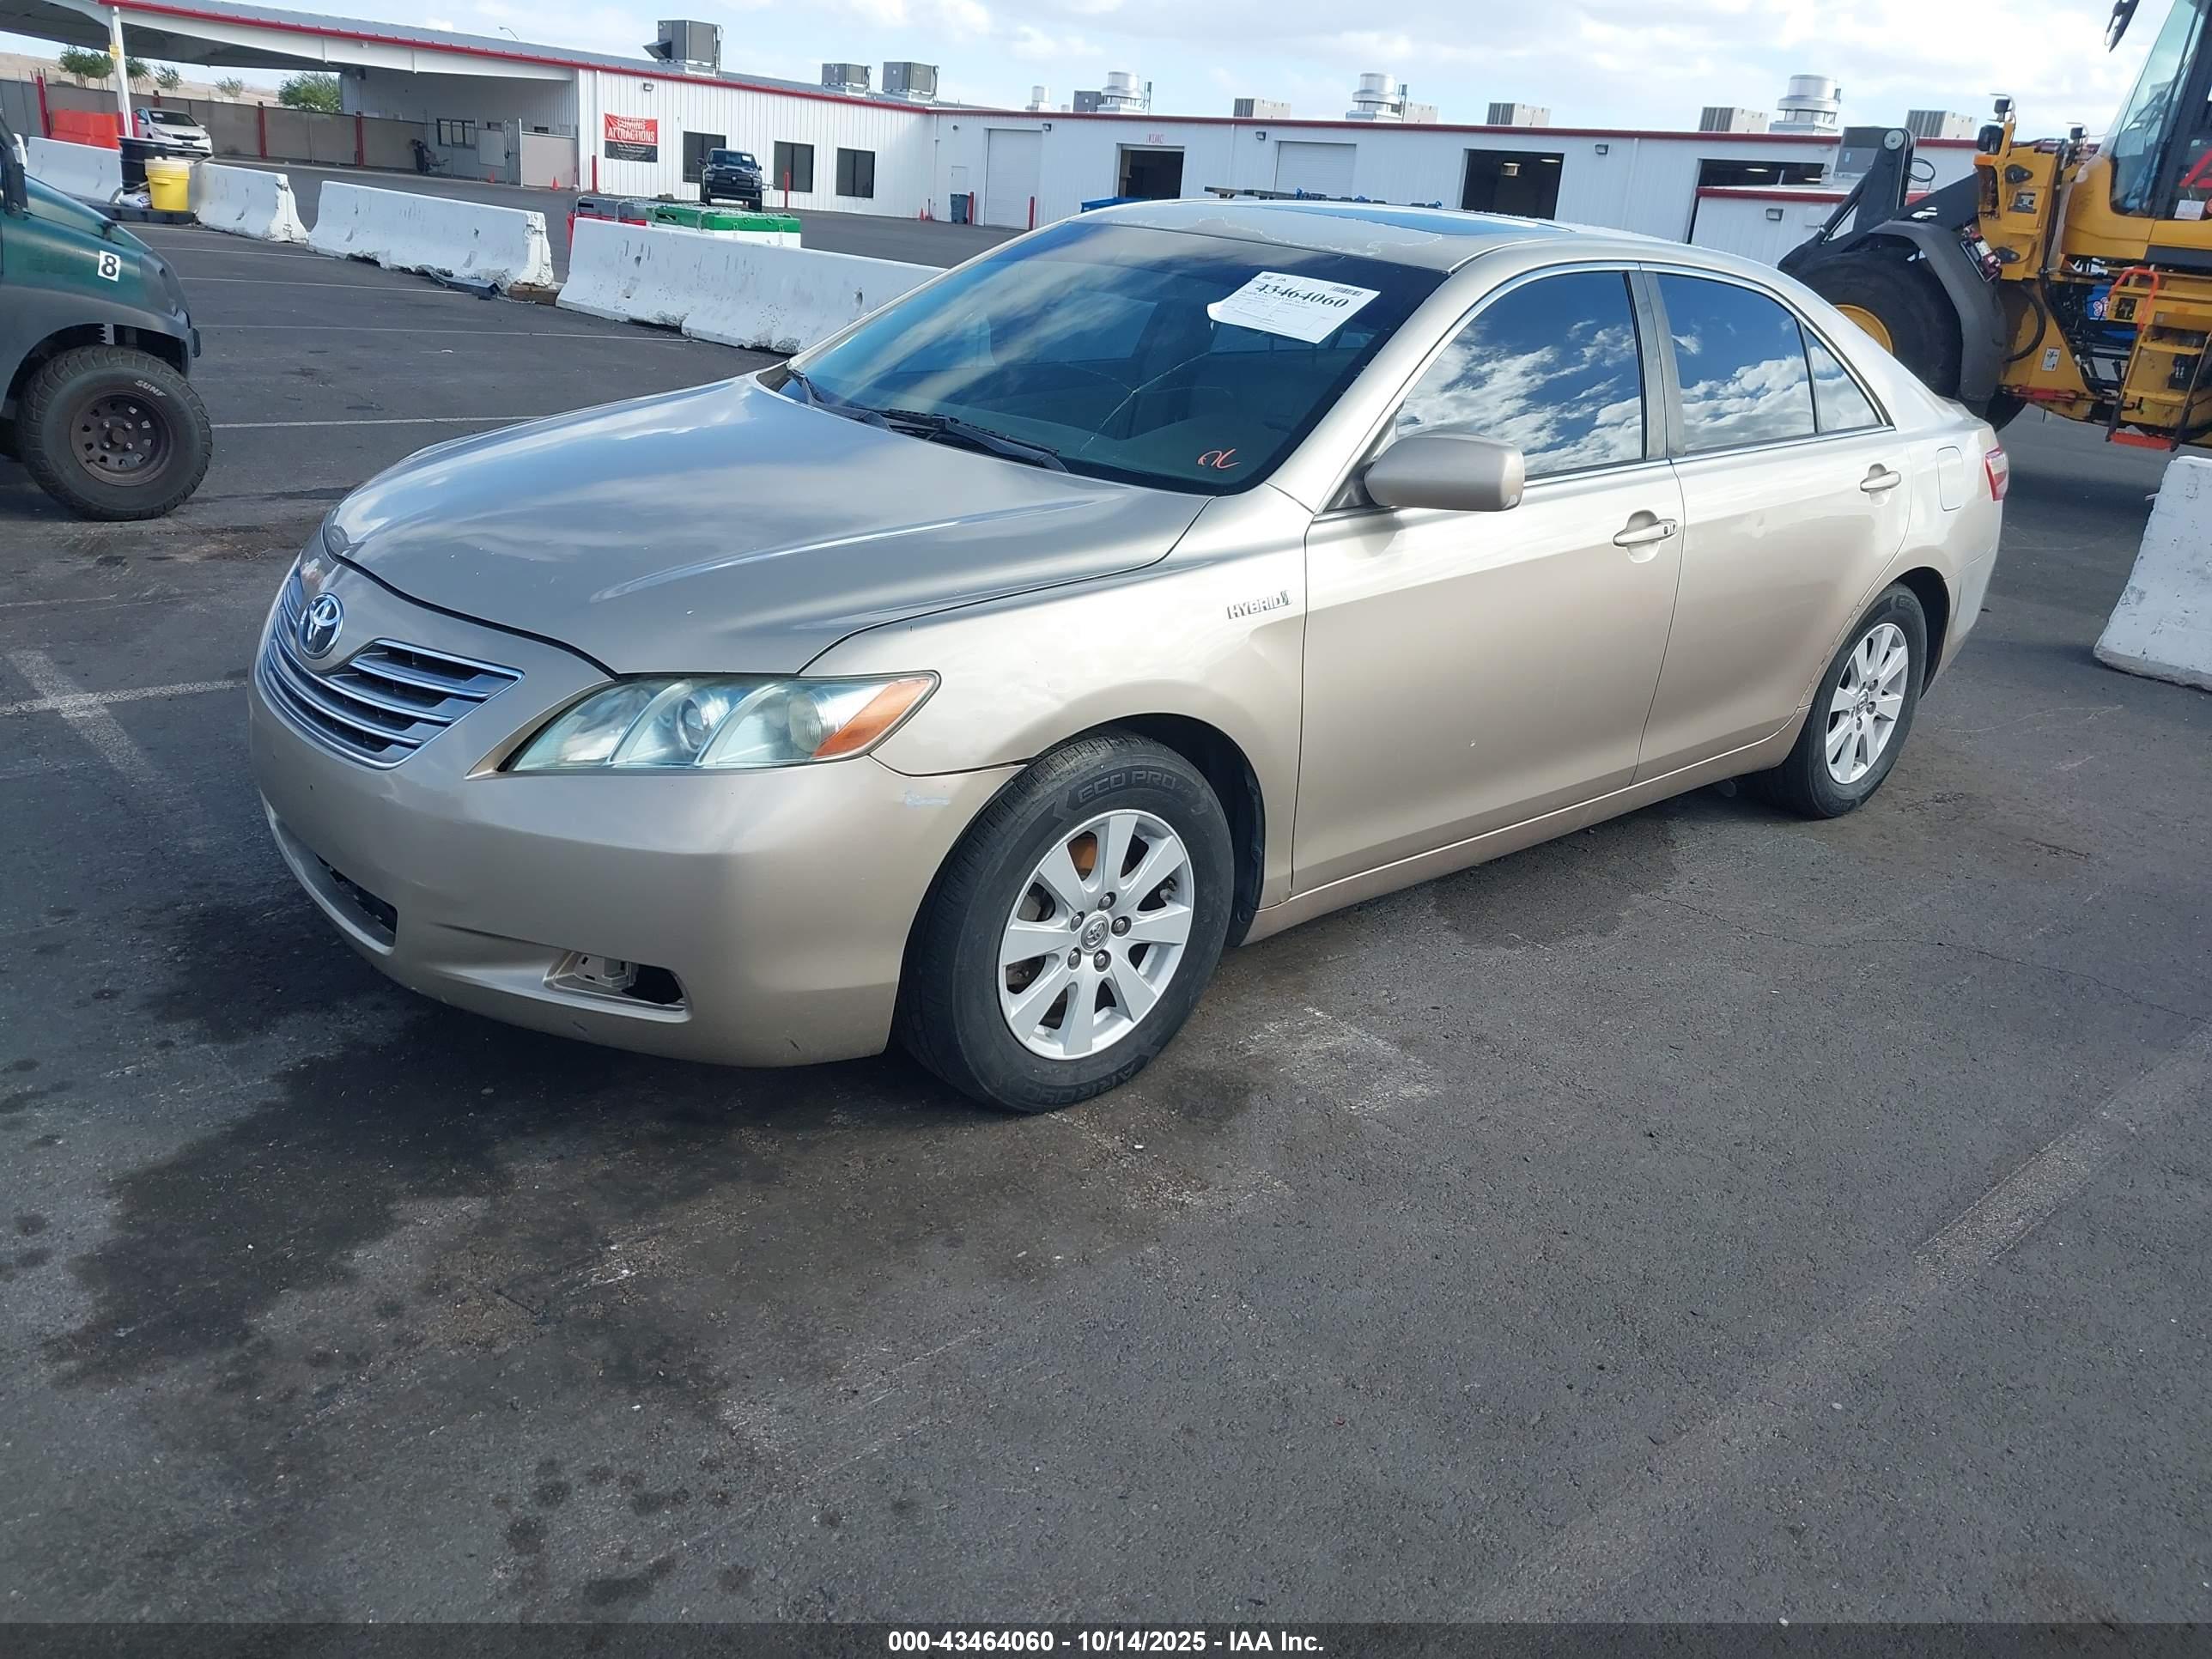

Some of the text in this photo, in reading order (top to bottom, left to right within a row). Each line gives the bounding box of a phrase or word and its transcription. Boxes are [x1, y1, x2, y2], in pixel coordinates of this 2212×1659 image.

[608, 126, 654, 142] ATTRACTIONS
[101, 254, 117, 277] 8
[1255, 283, 1349, 308] 43464060
[1226, 596, 1281, 619] HYBRID
[1078, 772, 1126, 803] ECO
[1131, 770, 1176, 790] PRO
